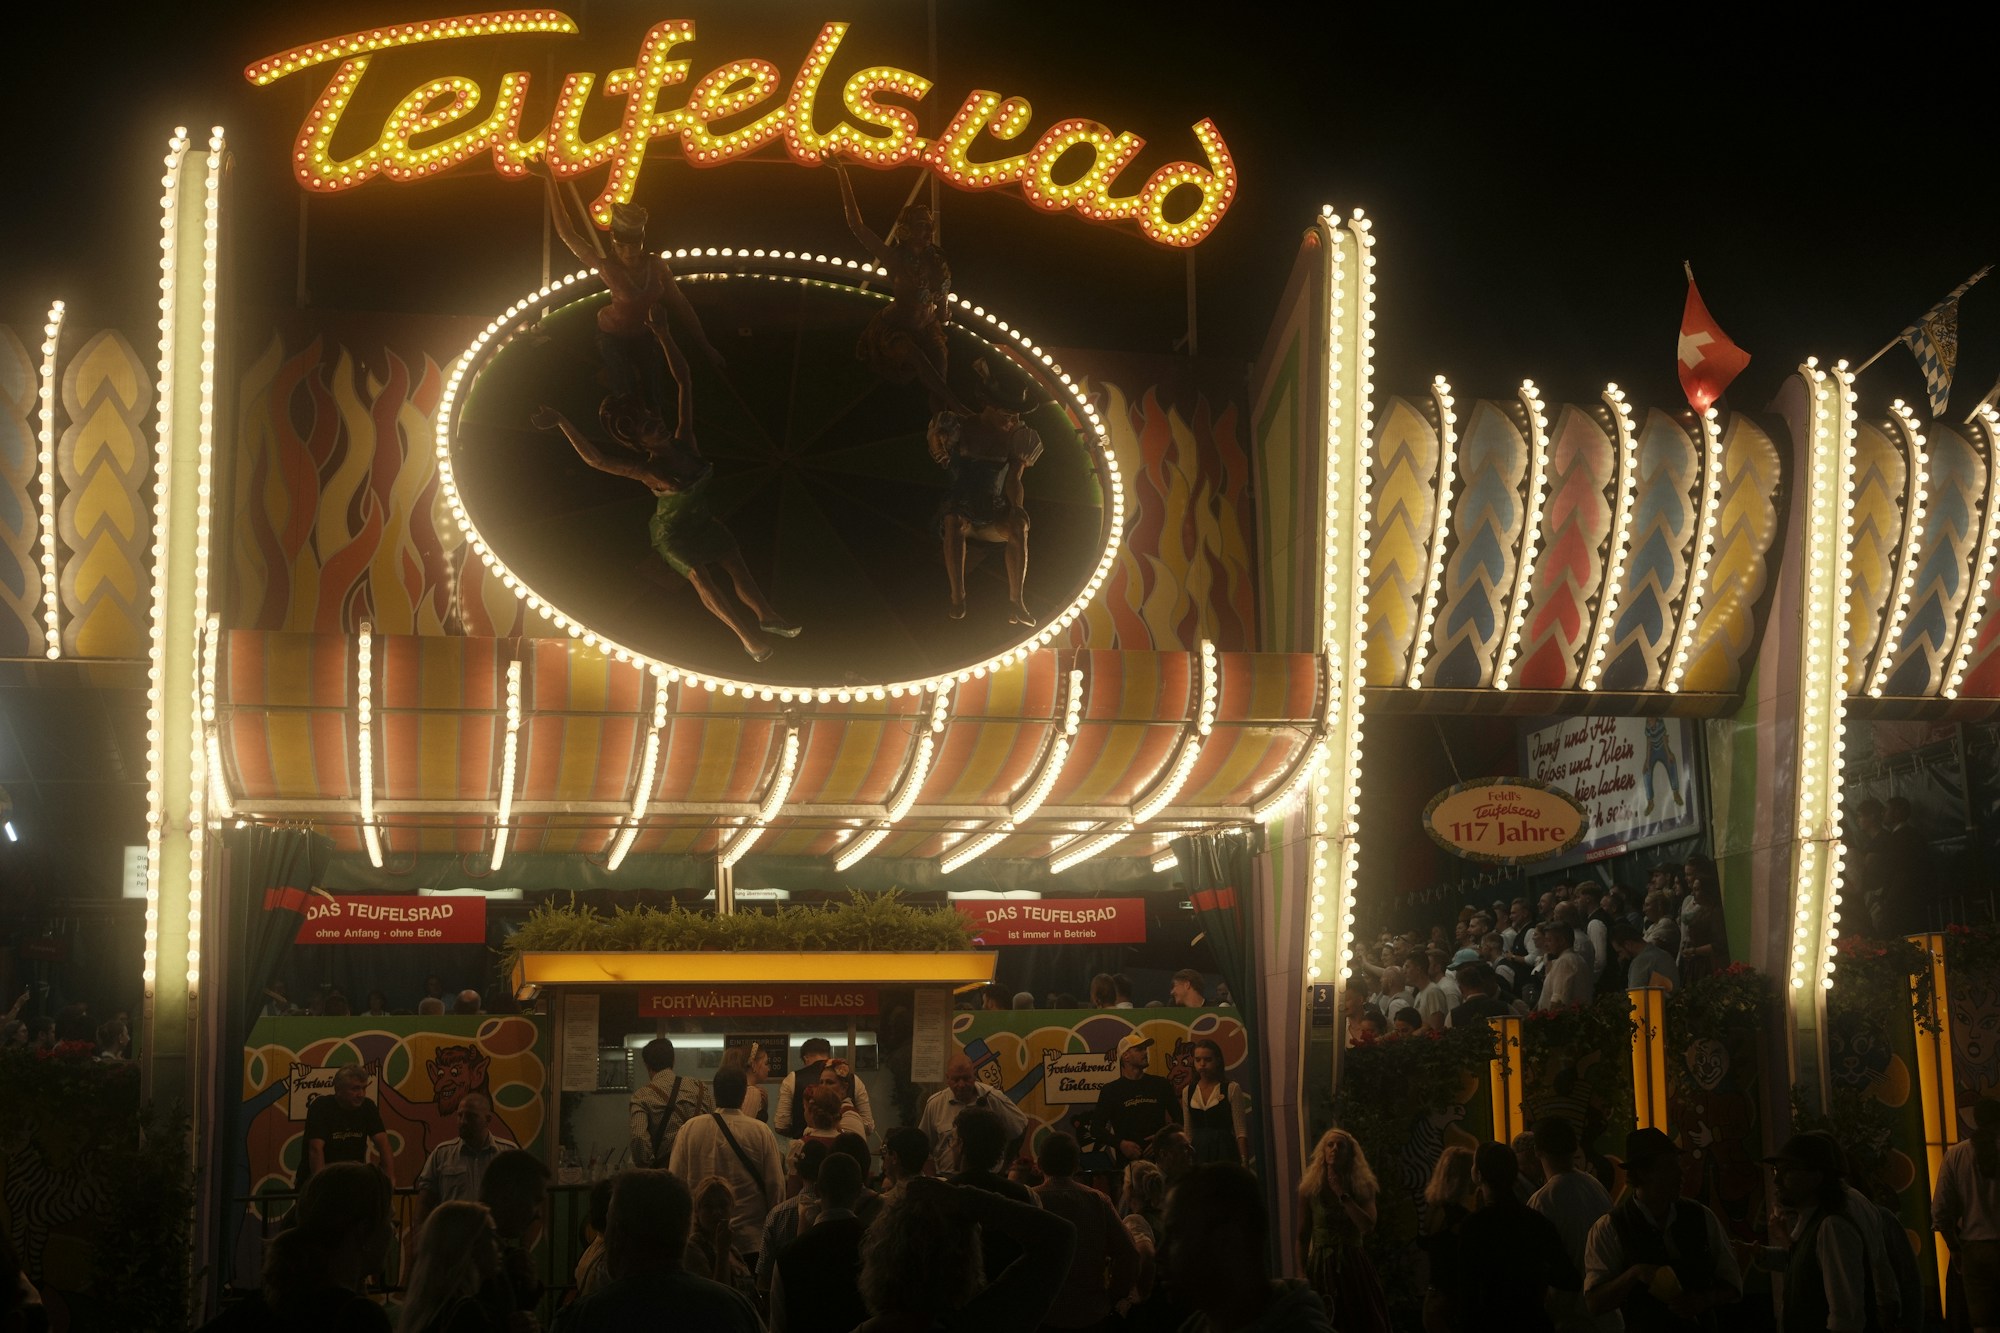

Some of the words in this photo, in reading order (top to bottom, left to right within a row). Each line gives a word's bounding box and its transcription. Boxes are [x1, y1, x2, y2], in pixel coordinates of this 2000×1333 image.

[244, 8, 1238, 249] Teufelsrad
[1533, 732, 1560, 762] Jung
[1564, 716, 1588, 749] und
[1590, 716, 1616, 740] Alt
[1569, 745, 1593, 775] und
[1596, 735, 1634, 768] Klein
[1574, 777, 1597, 802] hier
[1597, 765, 1636, 796] lachen
[1473, 803, 1541, 819] Teufelsrad
[1450, 822, 1489, 842] 117
[1498, 820, 1566, 846] Jahre
[307, 902, 342, 920] DAS
[347, 902, 454, 922] TEUFELSRAD
[986, 906, 1018, 924] DAS
[1022, 905, 1117, 924] TEUFELSRAD
[315, 928, 341, 938] ohne
[344, 928, 380, 940] Anfang
[389, 928, 414, 938] ohne
[417, 928, 442, 938] Ende
[1008, 930, 1020, 939] ist
[1022, 930, 1051, 939] immer
[1053, 929, 1062, 939] in
[1064, 929, 1097, 939] Betrieb
[651, 991, 775, 1009] FORTWÄHREND
[798, 994, 865, 1008] EINLASS
[1318, 988, 1327, 1003] 3
[1047, 1061, 1116, 1078] Fortwährend
[1059, 1077, 1105, 1092] Einlass
